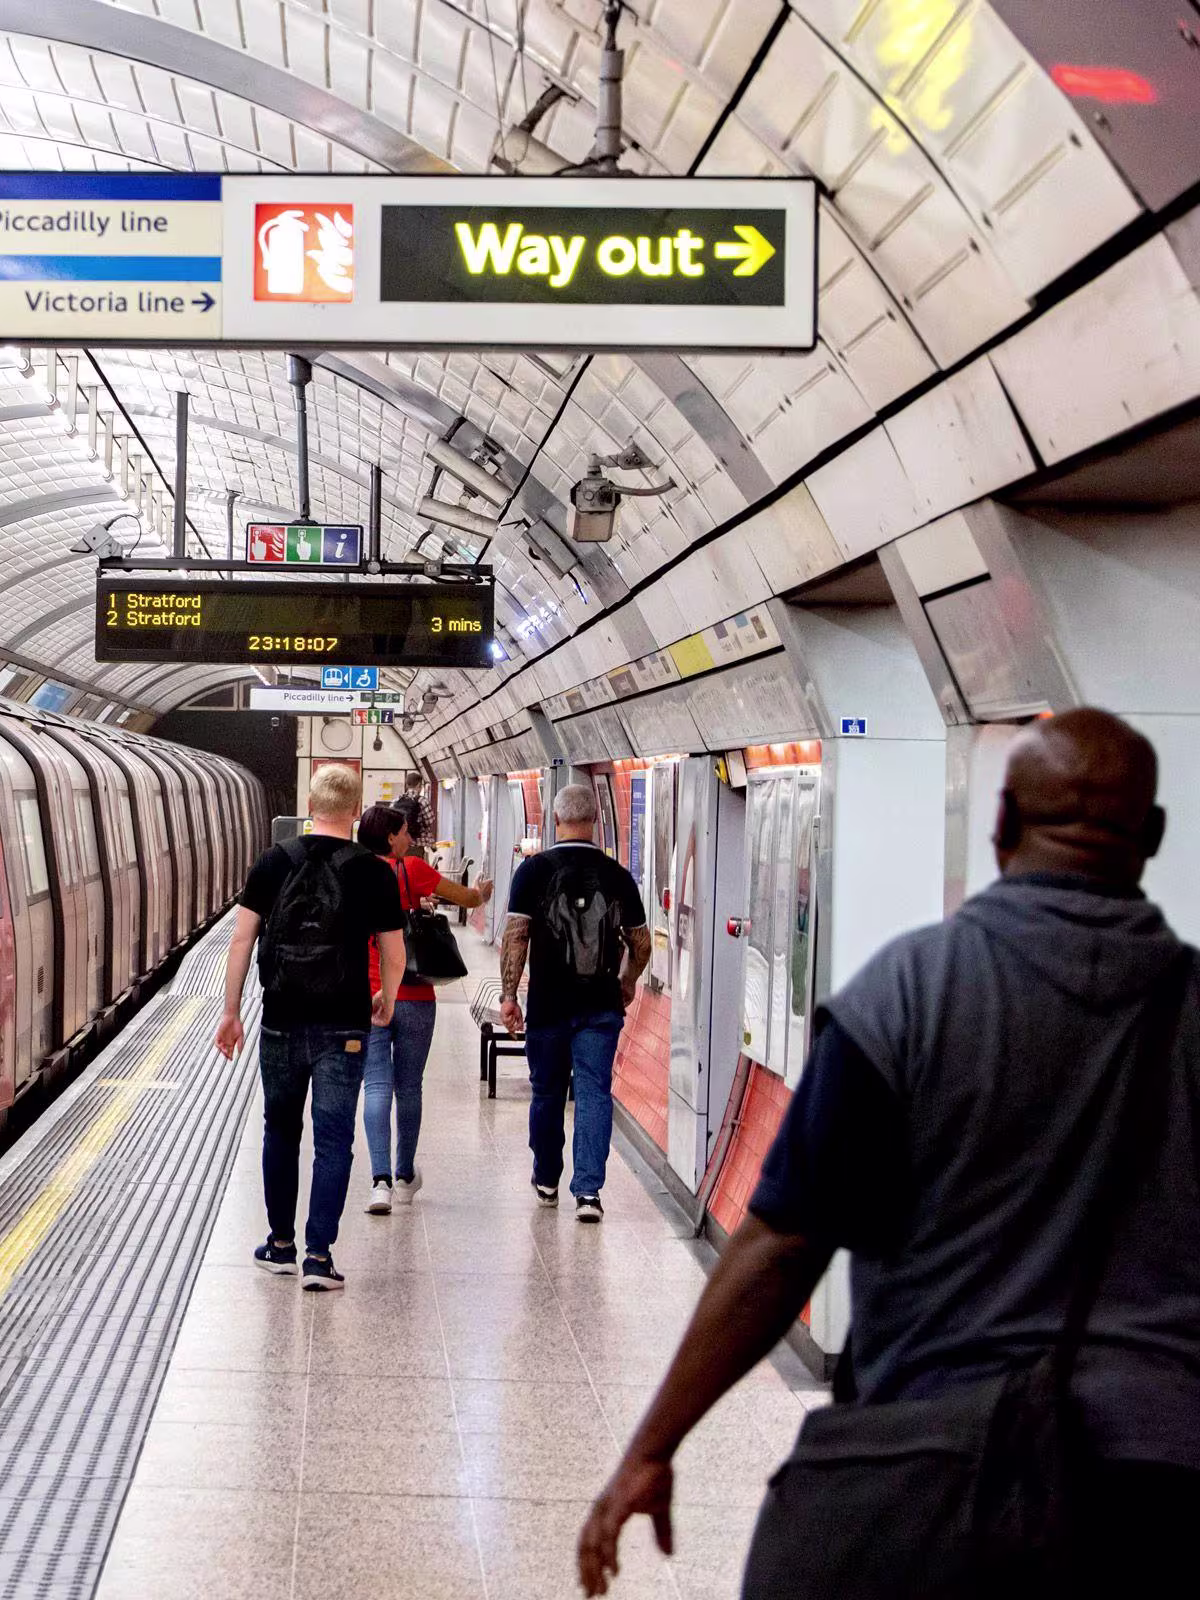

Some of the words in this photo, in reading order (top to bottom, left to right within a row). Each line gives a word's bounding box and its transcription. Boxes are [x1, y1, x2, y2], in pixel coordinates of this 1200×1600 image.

[120, 211, 169, 233] line
[455, 223, 585, 287] Way
[597, 230, 704, 276] out
[25, 291, 129, 313] Victoria
[138, 292, 186, 313] line
[109, 594, 116, 608] 1
[127, 593, 201, 609] Stratford
[106, 611, 118, 626] 2
[127, 610, 201, 627] Stratford
[431, 617, 442, 632] 3
[449, 617, 482, 633] mins
[248, 636, 338, 652] 23:18:07
[284, 692, 325, 704] Piccadilly
[328, 693, 345, 703] line
